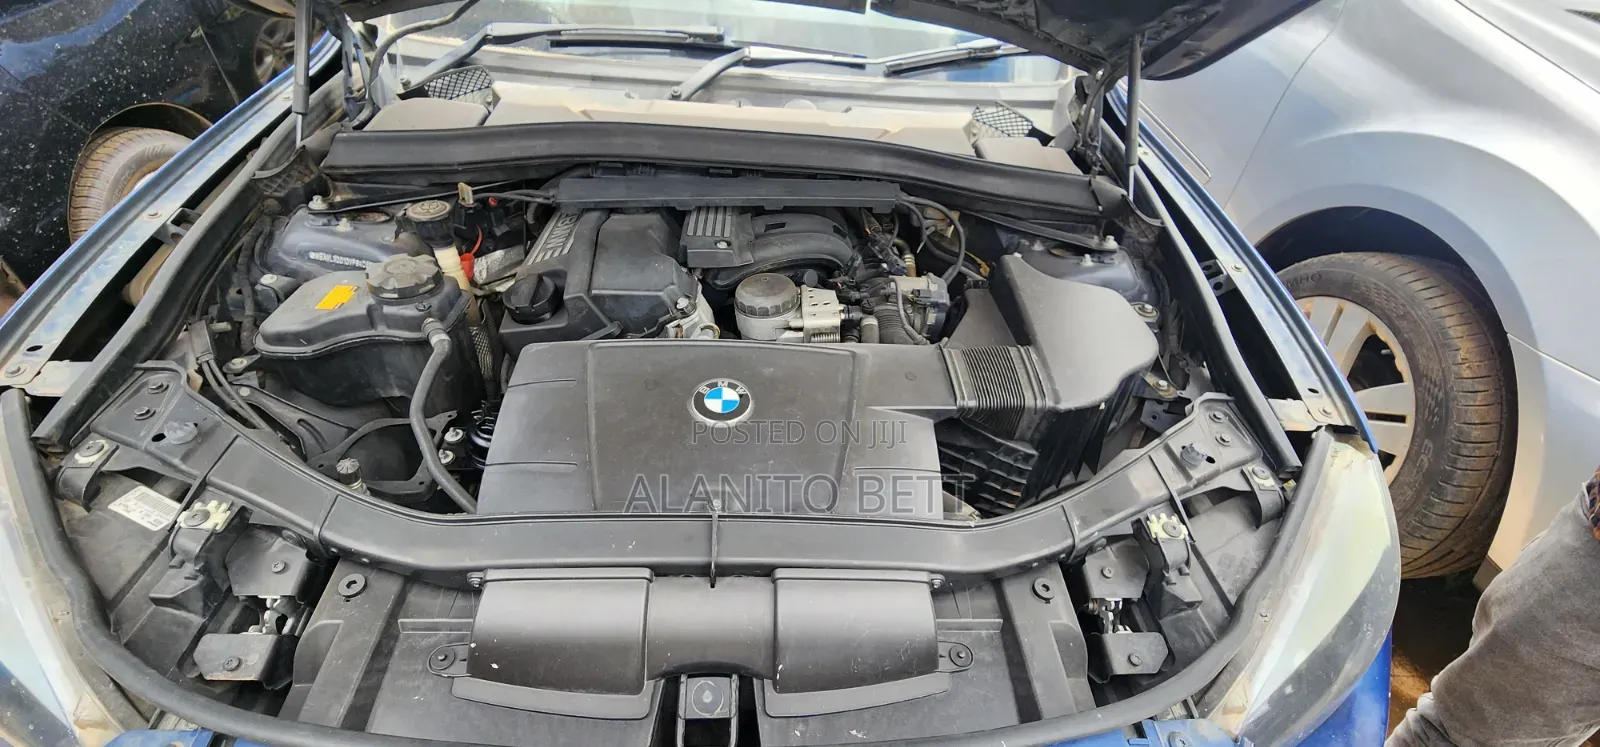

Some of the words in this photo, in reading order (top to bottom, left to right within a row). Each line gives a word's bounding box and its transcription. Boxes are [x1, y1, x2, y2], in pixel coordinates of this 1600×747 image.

[545, 213, 579, 249] BMW
[1285, 272, 1322, 287] MHO
[698, 380, 747, 394] BMW
